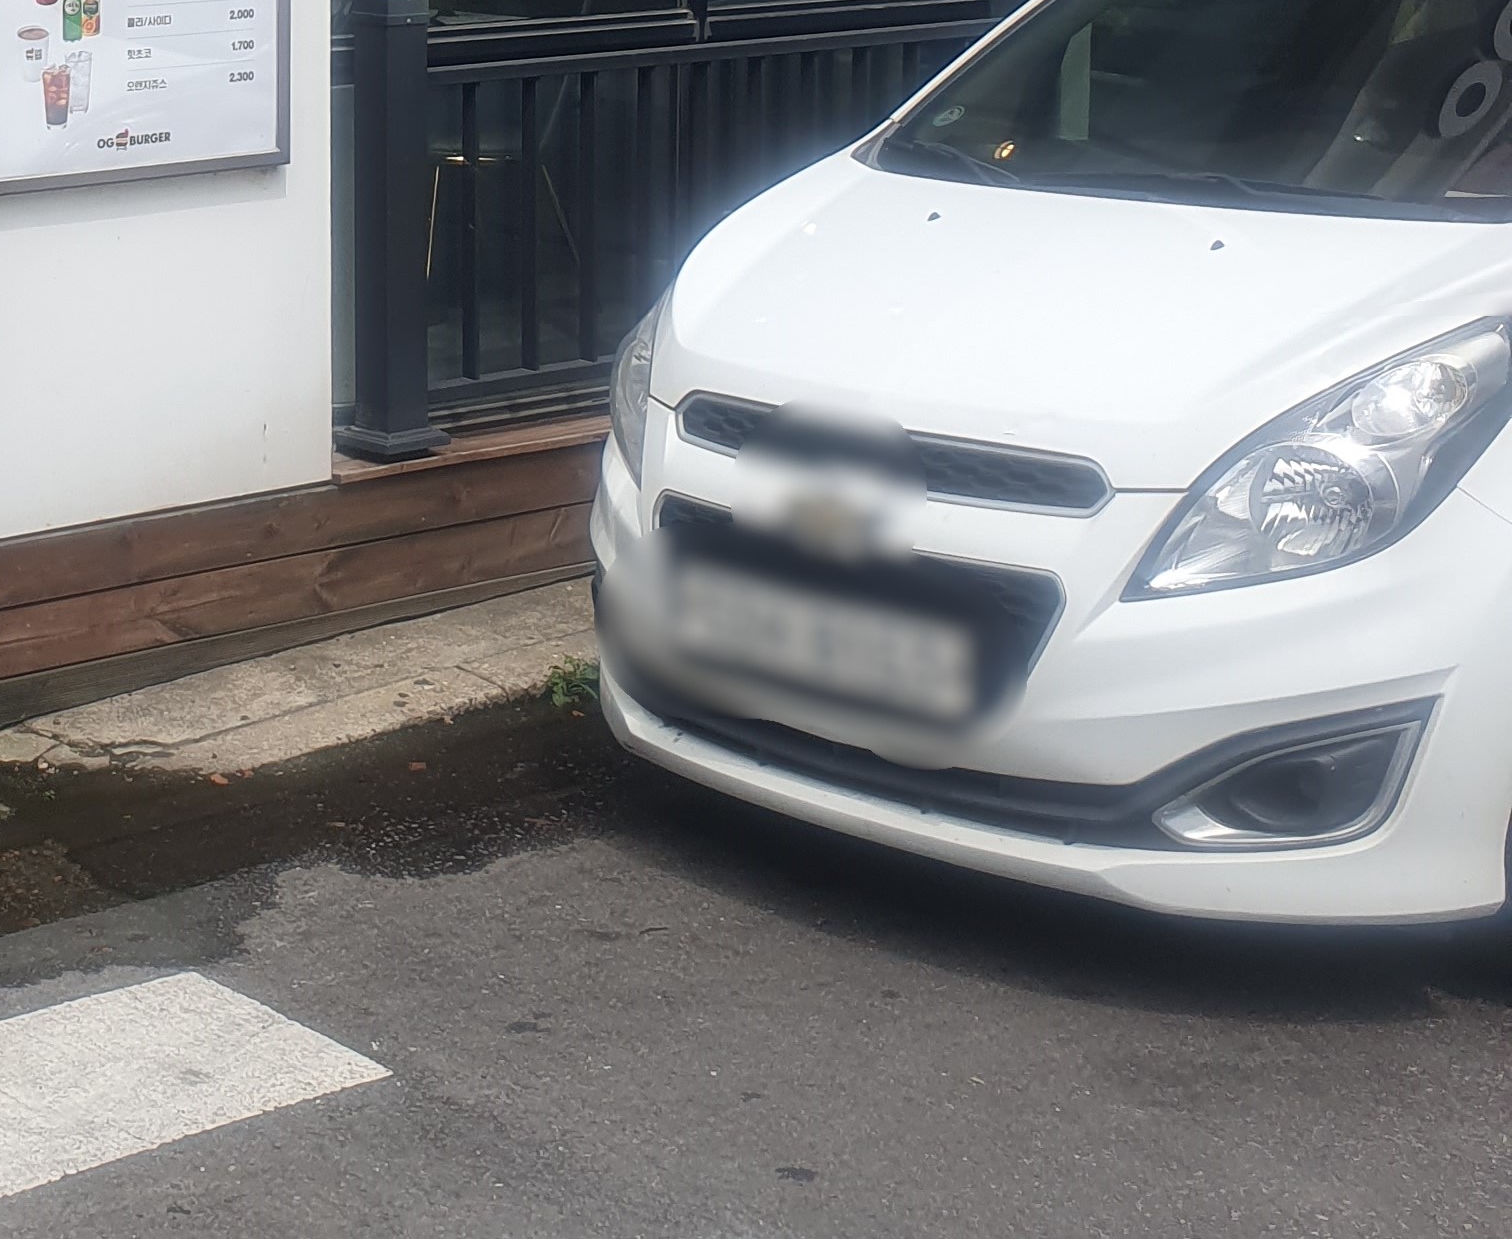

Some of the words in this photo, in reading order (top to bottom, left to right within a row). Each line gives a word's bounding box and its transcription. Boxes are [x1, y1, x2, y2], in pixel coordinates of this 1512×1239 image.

[229, 9, 254, 20] 2,000
[127, 48, 152, 60] 핫초코
[231, 40, 254, 51] 1,700
[229, 71, 254, 82] 2,300
[97, 138, 114, 149] OG
[129, 131, 171, 146] BURGER
